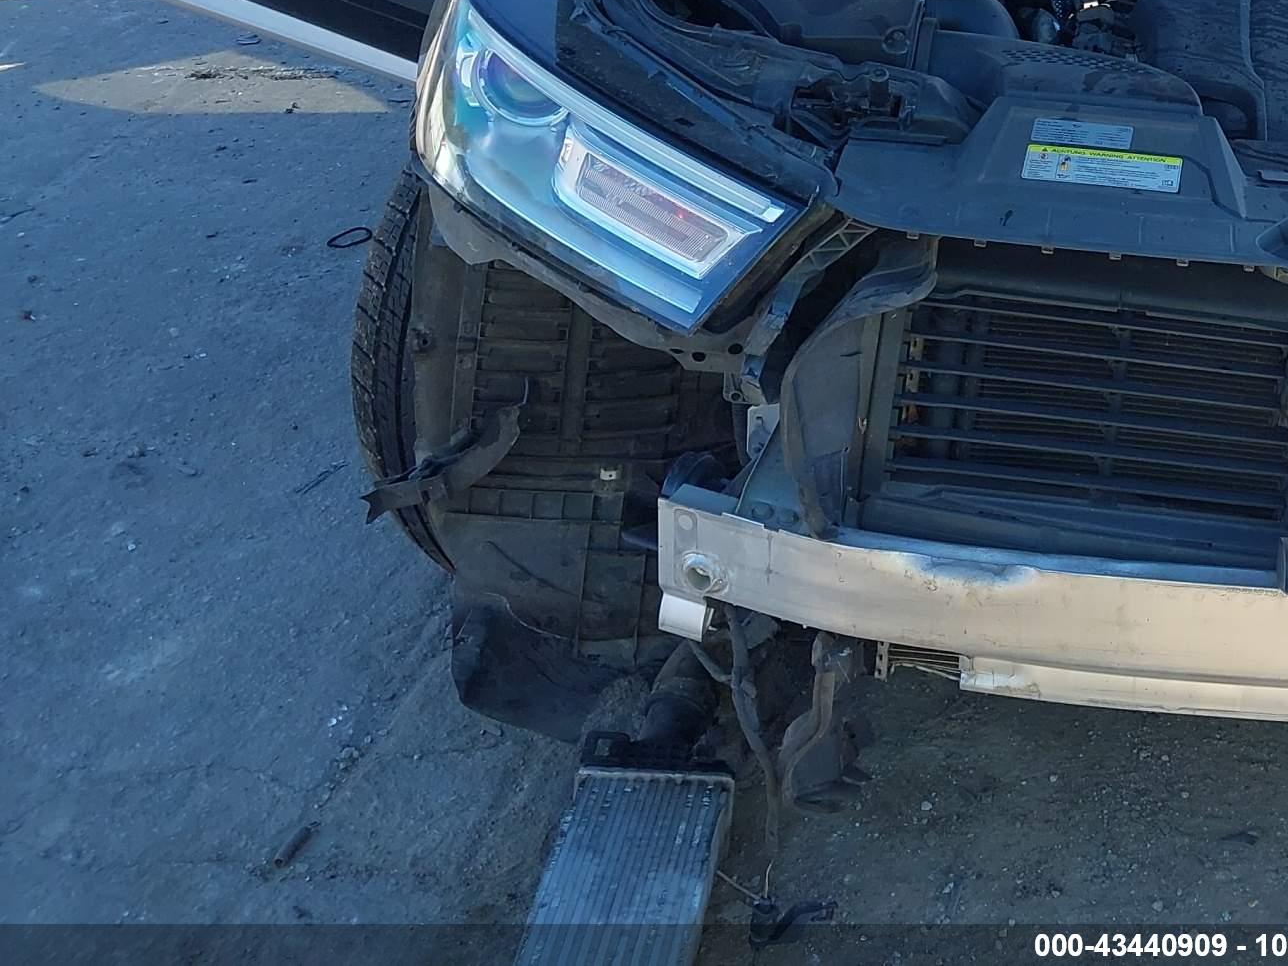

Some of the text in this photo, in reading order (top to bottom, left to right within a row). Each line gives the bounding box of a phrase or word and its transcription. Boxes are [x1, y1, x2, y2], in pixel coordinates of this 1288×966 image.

[1051, 147, 1168, 163] ACHTUNG WARNING ATTENTION
